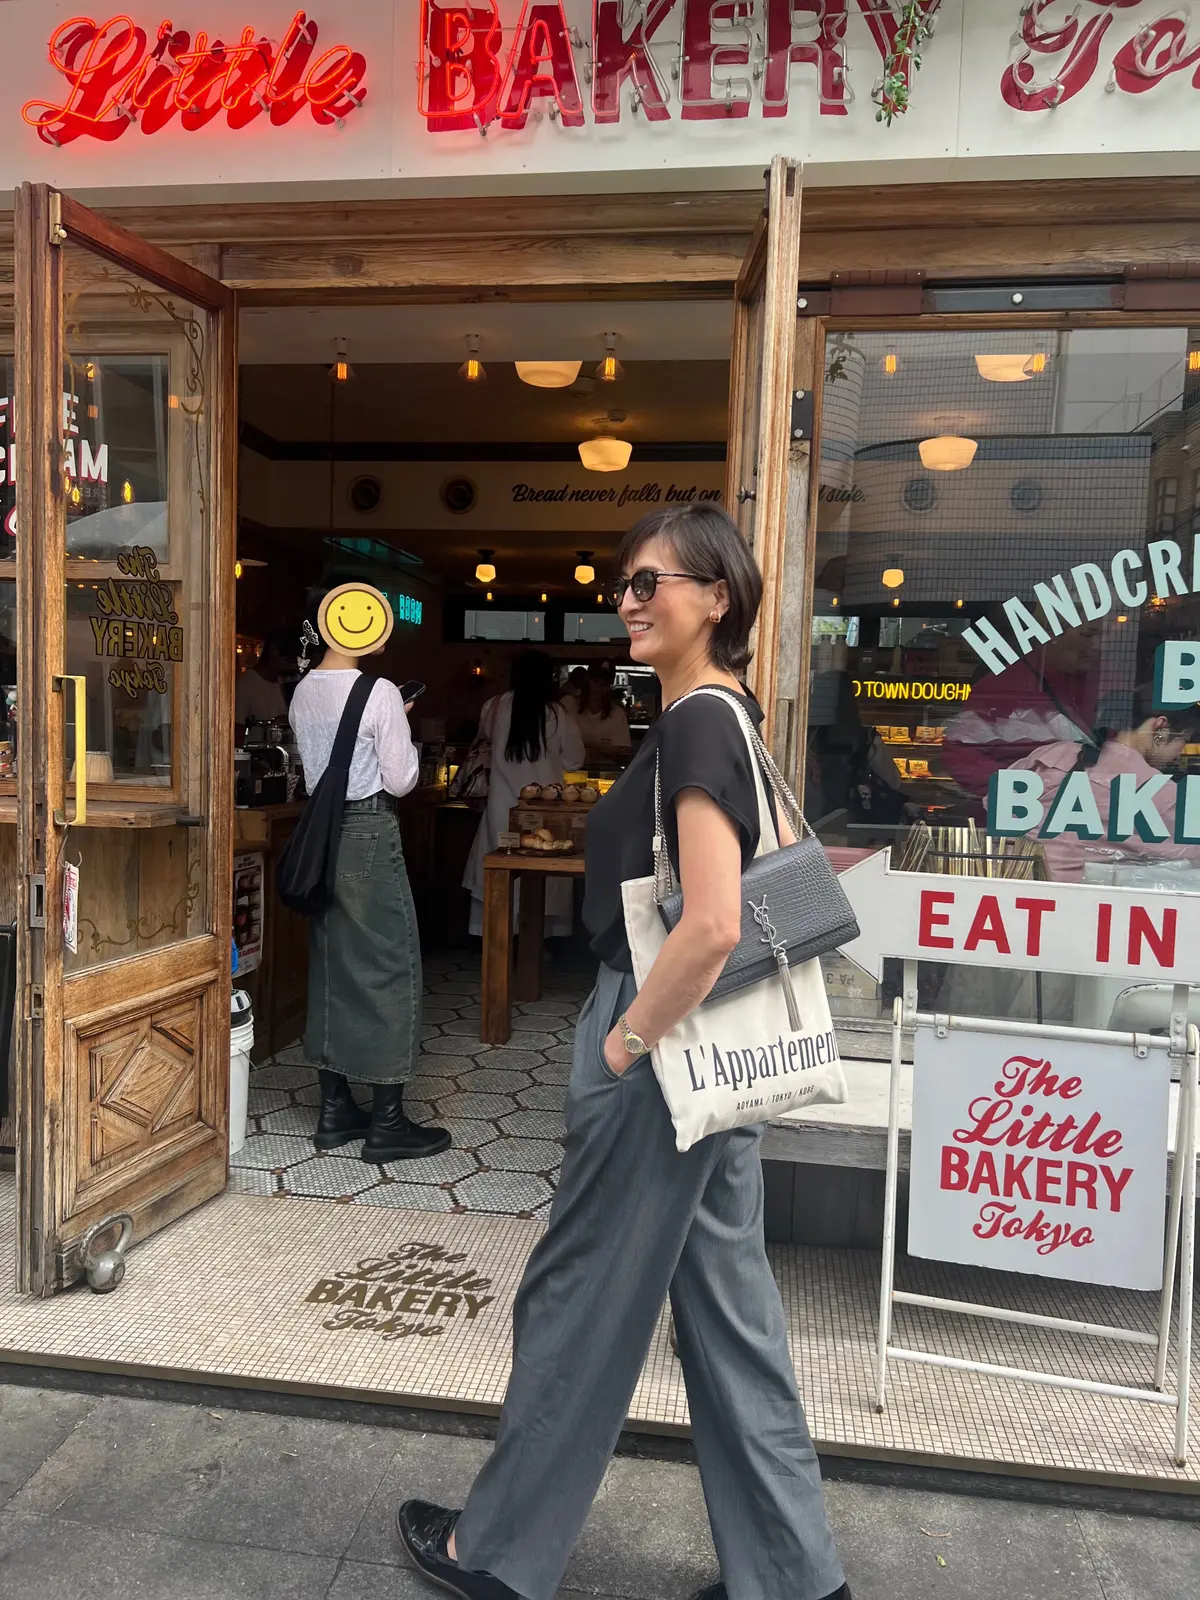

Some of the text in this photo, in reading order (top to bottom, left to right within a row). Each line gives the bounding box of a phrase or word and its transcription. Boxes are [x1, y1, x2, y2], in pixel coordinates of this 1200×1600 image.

[22, 11, 367, 146] Little
[416, 0, 942, 133] BAKERY
[512, 484, 568, 502] Bread
[568, 489, 616, 502] never
[617, 483, 661, 507] falls
[665, 484, 697, 502] but
[698, 489, 723, 502] on
[863, 681, 909, 699] TOWN
[918, 890, 1177, 968] EAT IN
[994, 1056, 1083, 1099] The
[736, 1098, 763, 1111] AOYAMA
[772, 1091, 792, 1103] TOKYO
[799, 1085, 815, 1097] KOBE
[952, 1097, 1123, 1158] Little
[940, 1146, 1134, 1212] BAKERY
[972, 1202, 1095, 1255] Tokyo
[387, 1242, 468, 1263] The
[334, 1258, 492, 1291] Little
[305, 1279, 496, 1319] BAKERY
[323, 1309, 444, 1341] Tokyo
